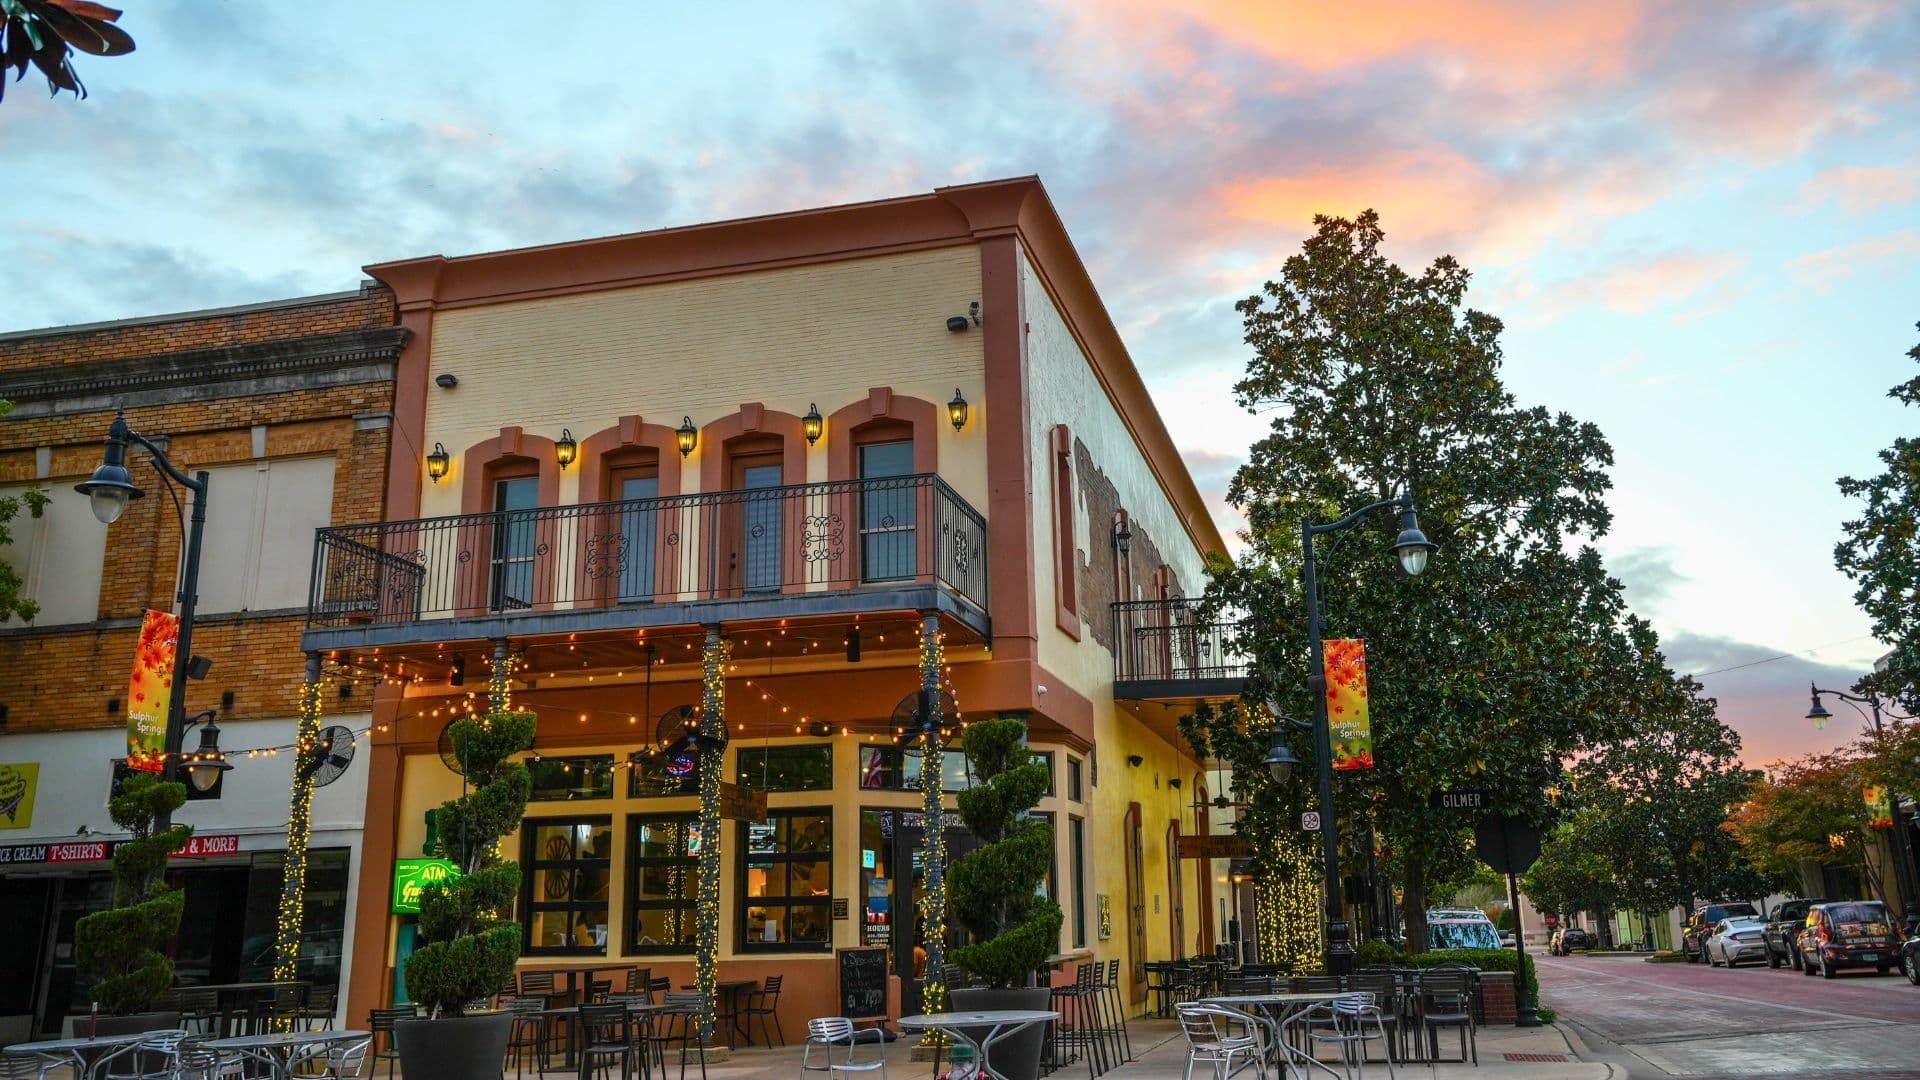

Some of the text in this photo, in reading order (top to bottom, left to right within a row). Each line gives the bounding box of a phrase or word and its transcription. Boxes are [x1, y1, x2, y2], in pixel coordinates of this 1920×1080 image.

[129, 710, 159, 721] Sulphur
[136, 721, 167, 736] Springs
[1330, 720, 1361, 729] Sulphur
[1340, 729, 1370, 738] Springs
[1442, 793, 1481, 808] GILMER
[14, 846, 46, 861] CREAM
[51, 842, 104, 861] T-SHIRTS
[189, 839, 199, 853] &
[202, 837, 236, 853] MORE
[421, 866, 446, 880] ATM
